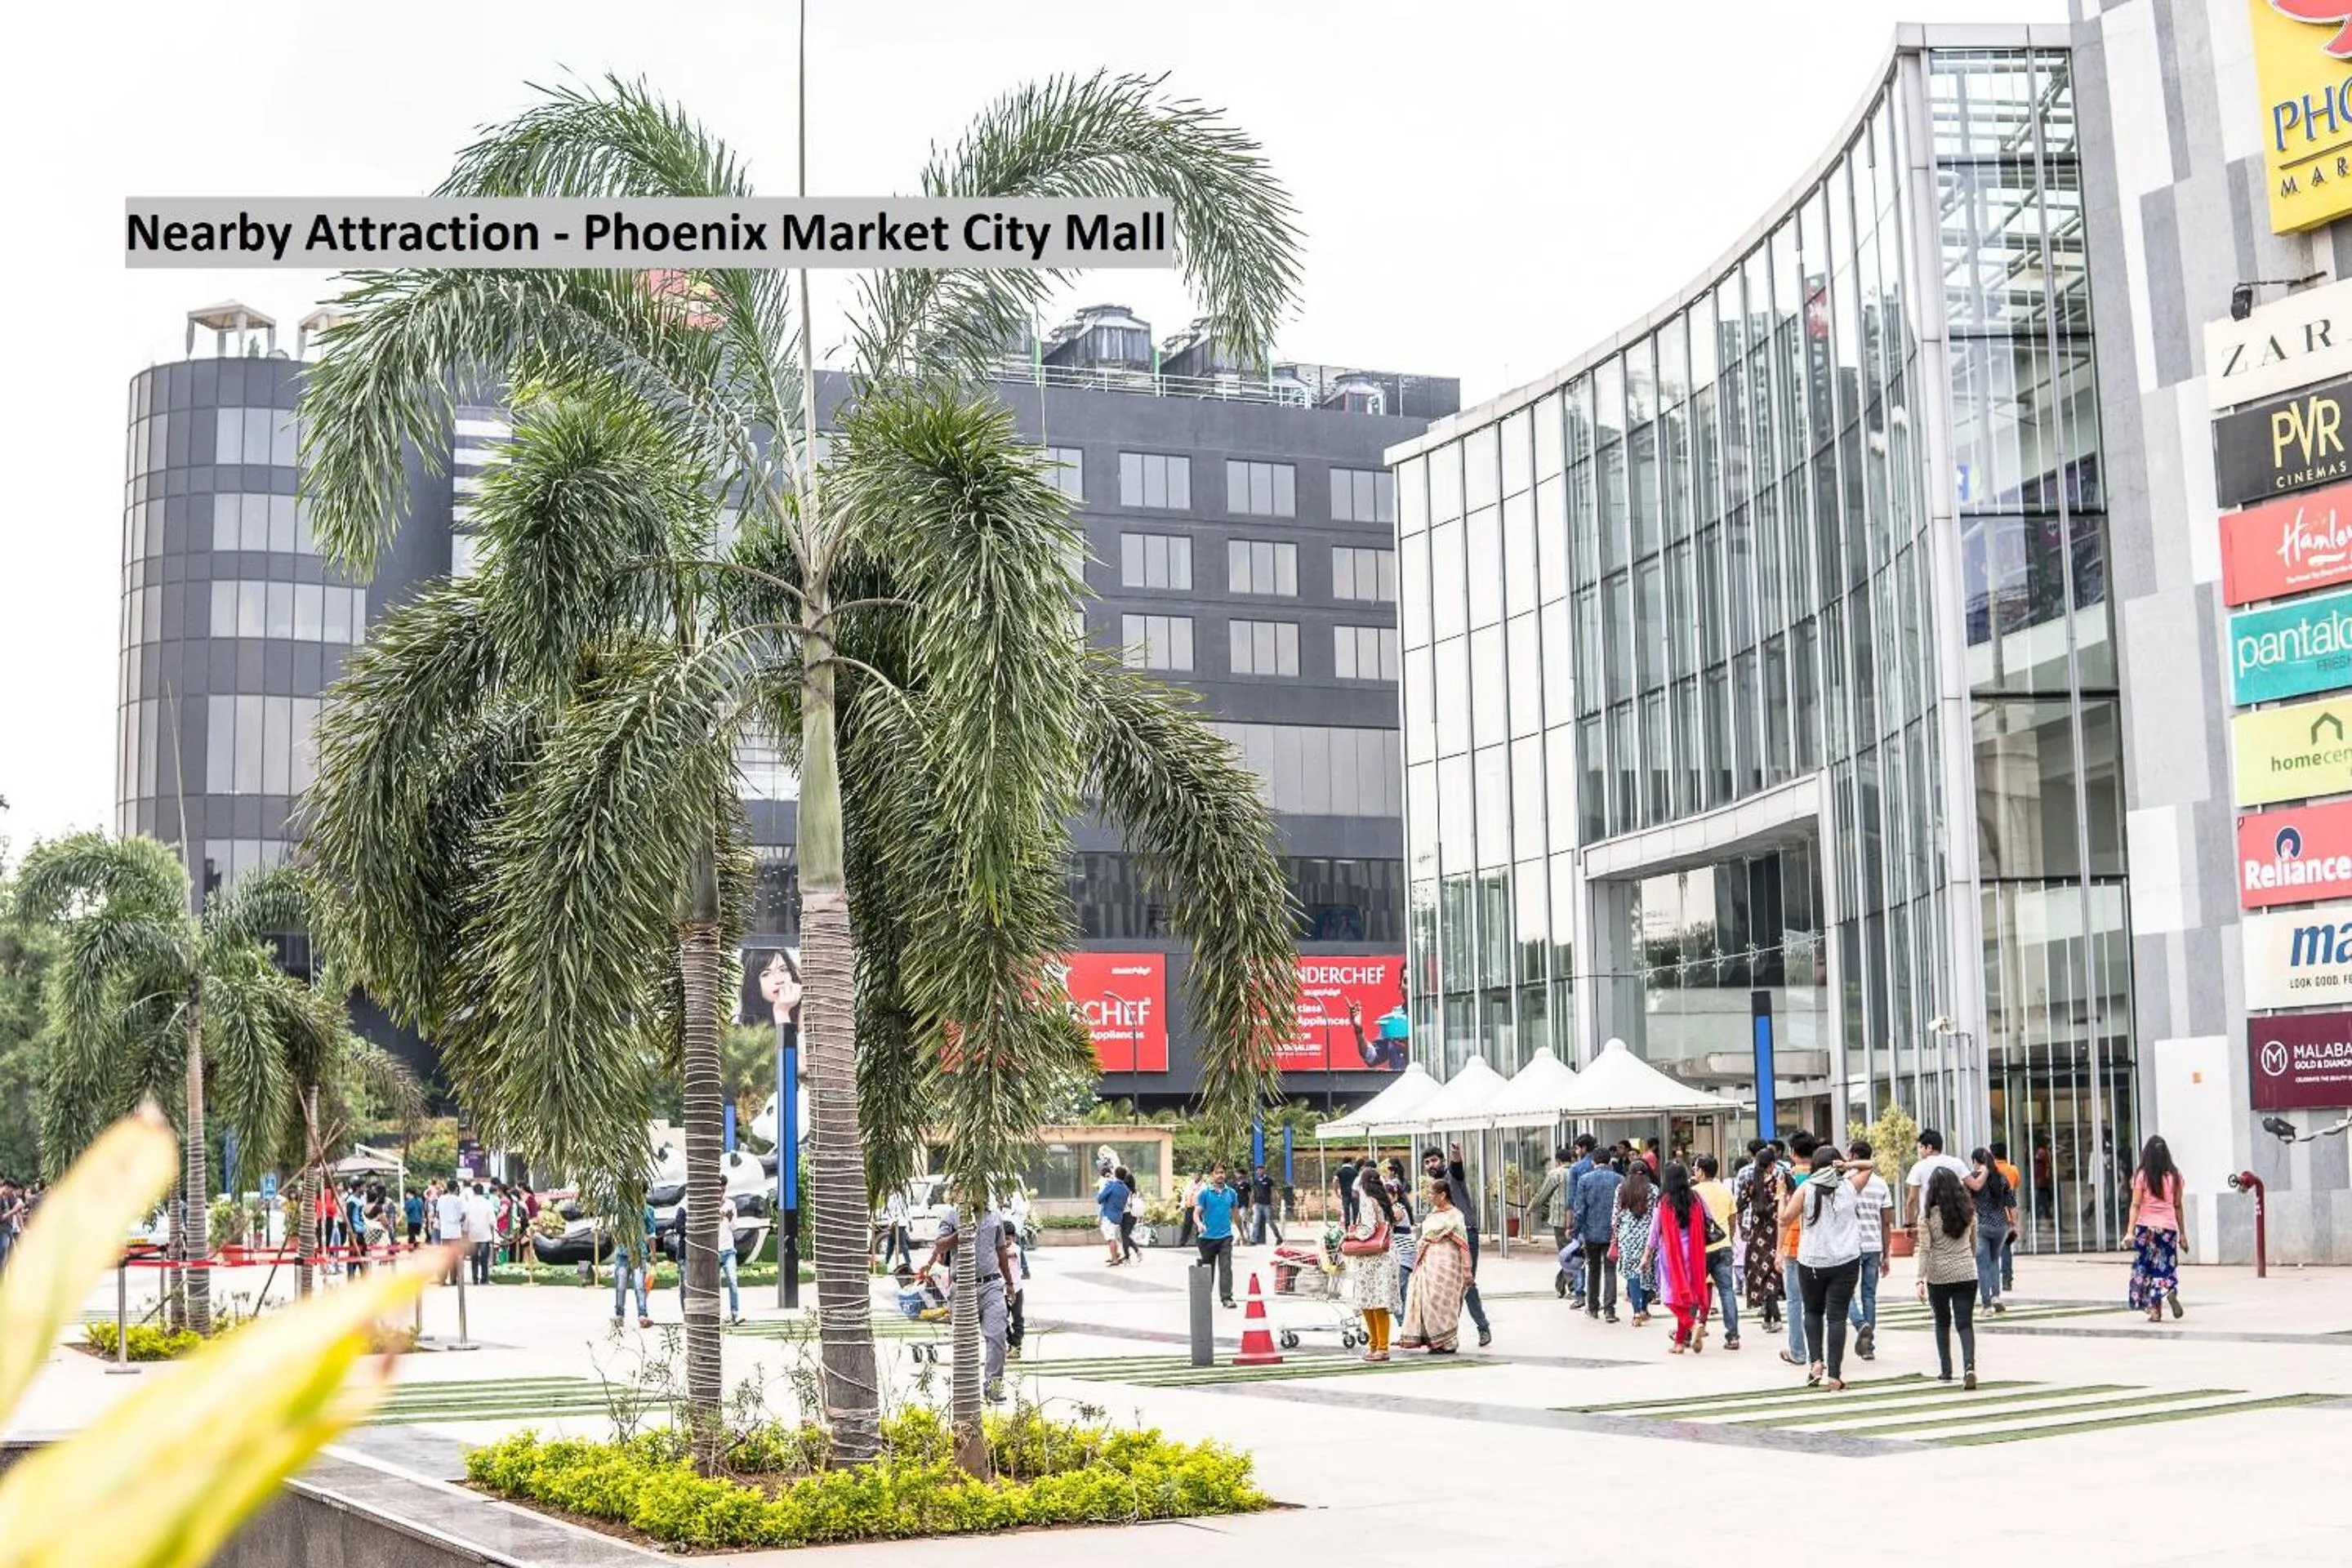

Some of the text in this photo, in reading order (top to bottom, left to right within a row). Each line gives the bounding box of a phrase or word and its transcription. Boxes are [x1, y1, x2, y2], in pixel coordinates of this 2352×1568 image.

[2221, 318, 2352, 377] ZAR
[2271, 396, 2345, 468] PVR
[2276, 461, 2347, 488] CINEMAS
[2245, 855, 2352, 890] Reliance
[2291, 922, 2352, 967] ma
[2290, 978, 2312, 989] LOOK
[2293, 1042, 2352, 1059] MALABA
[2295, 1060, 2316, 1070] GOLD
